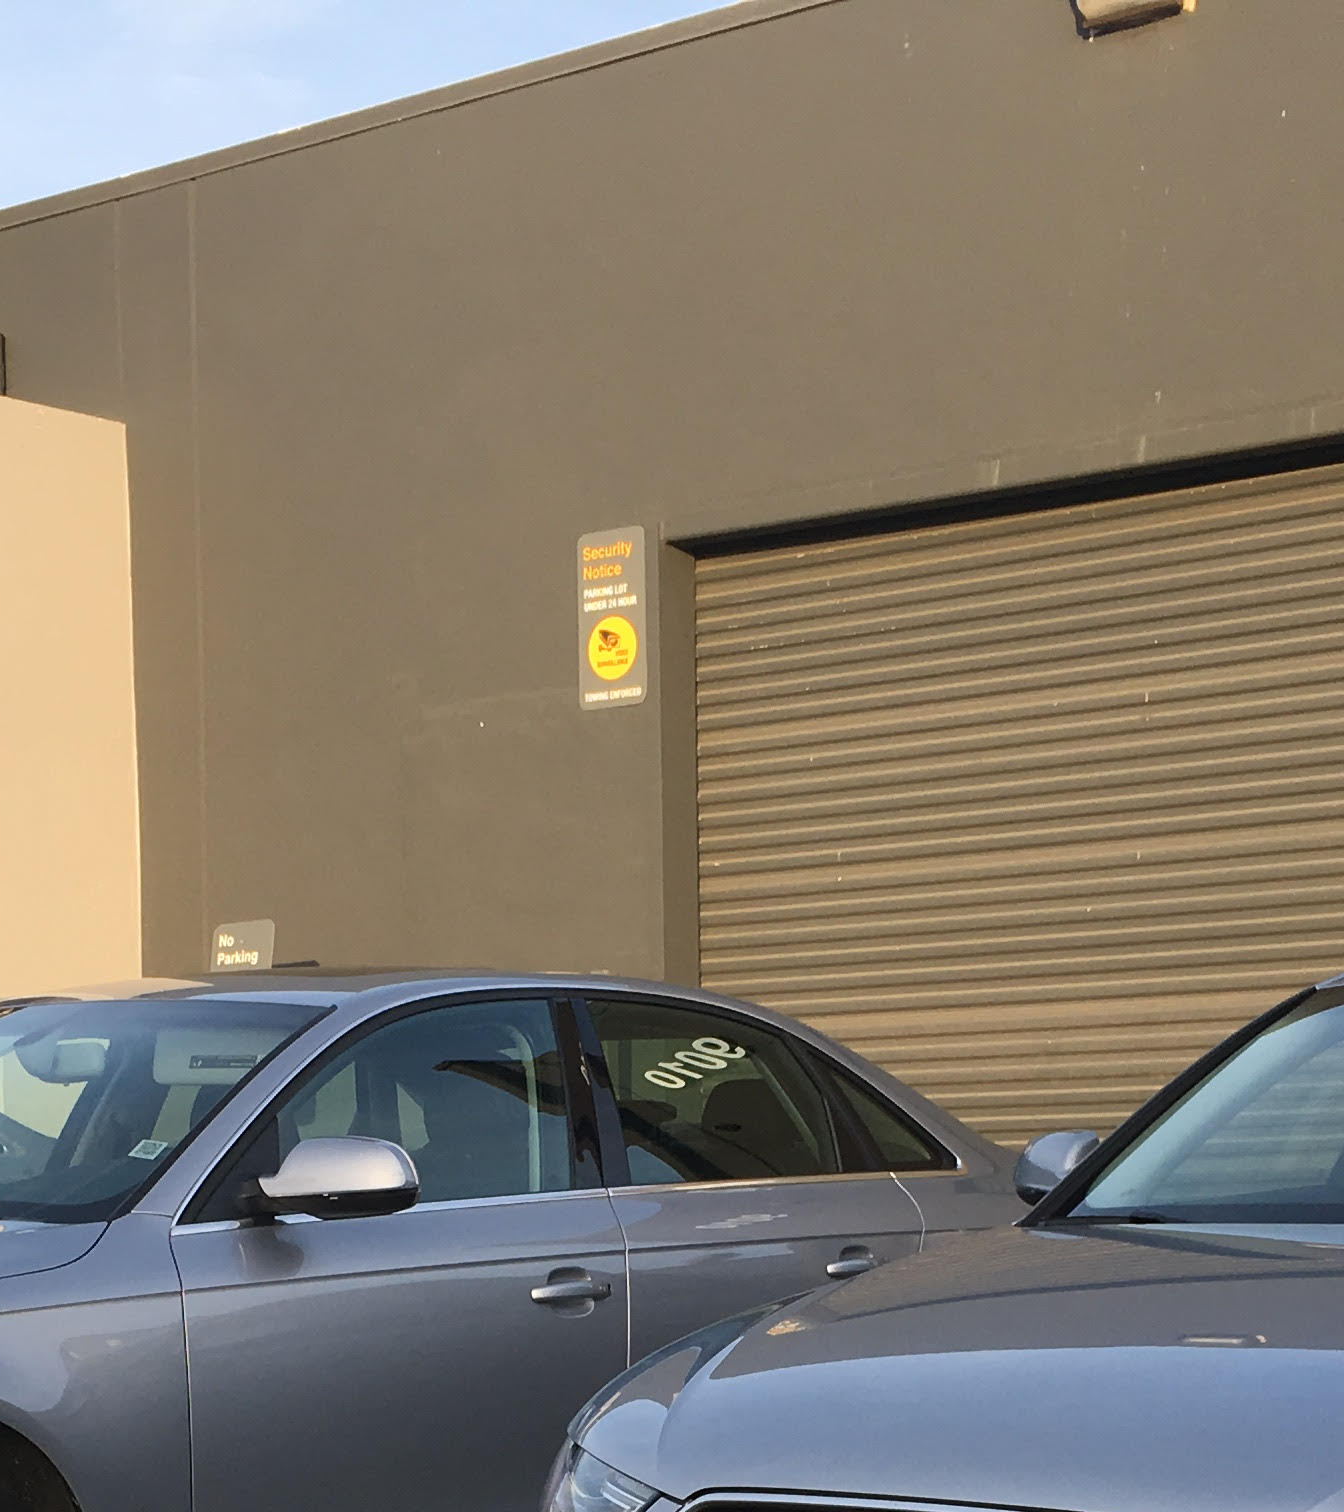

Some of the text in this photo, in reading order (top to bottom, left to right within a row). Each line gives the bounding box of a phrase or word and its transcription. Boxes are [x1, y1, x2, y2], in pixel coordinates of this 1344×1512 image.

[582, 541, 632, 561] Security
[583, 563, 622, 580] Notice
[614, 583, 628, 595] LOT
[218, 934, 234, 948] No
[217, 950, 259, 966] Parking
